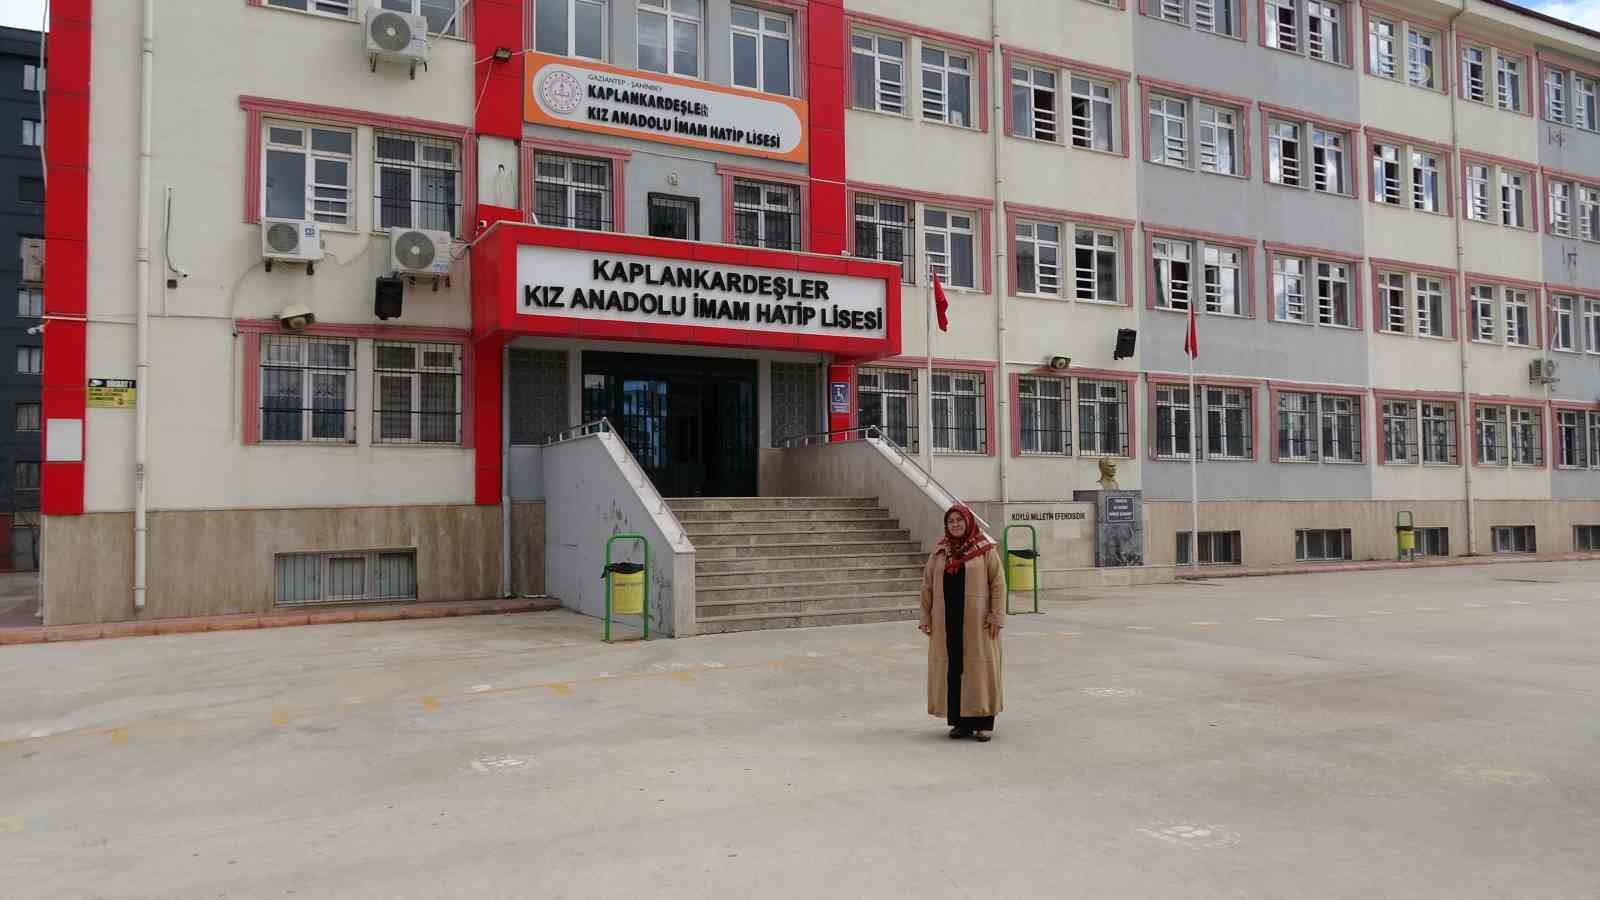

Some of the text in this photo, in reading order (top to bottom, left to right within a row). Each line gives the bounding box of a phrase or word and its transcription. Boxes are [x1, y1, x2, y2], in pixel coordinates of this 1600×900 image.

[588, 106, 781, 149] KIZ ANADOLU İMAM HATİP LİSESİ
[593, 259, 828, 300] KAPLANKARDEŞLER
[525, 285, 883, 330] KIZ ANADOLU İMAM HATİP LİSESİ
